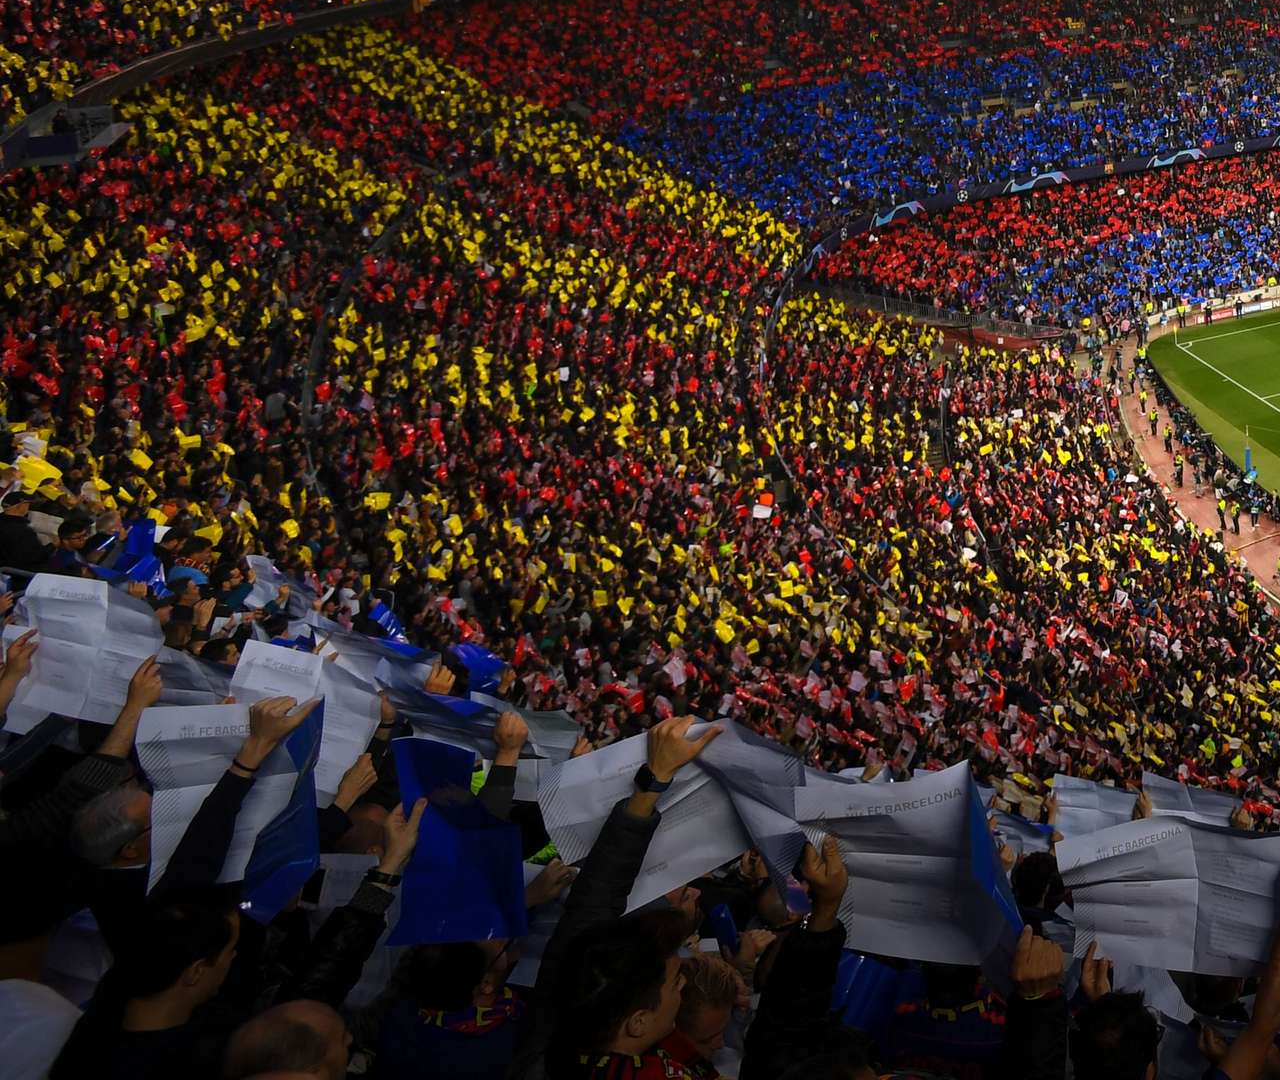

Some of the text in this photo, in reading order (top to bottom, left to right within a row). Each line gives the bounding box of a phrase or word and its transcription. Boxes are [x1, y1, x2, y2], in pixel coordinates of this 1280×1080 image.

[200, 724, 251, 737] FC BARCE
[866, 787, 962, 816] FC BARCELONA
[1112, 826, 1182, 856] FC BARCELONA
